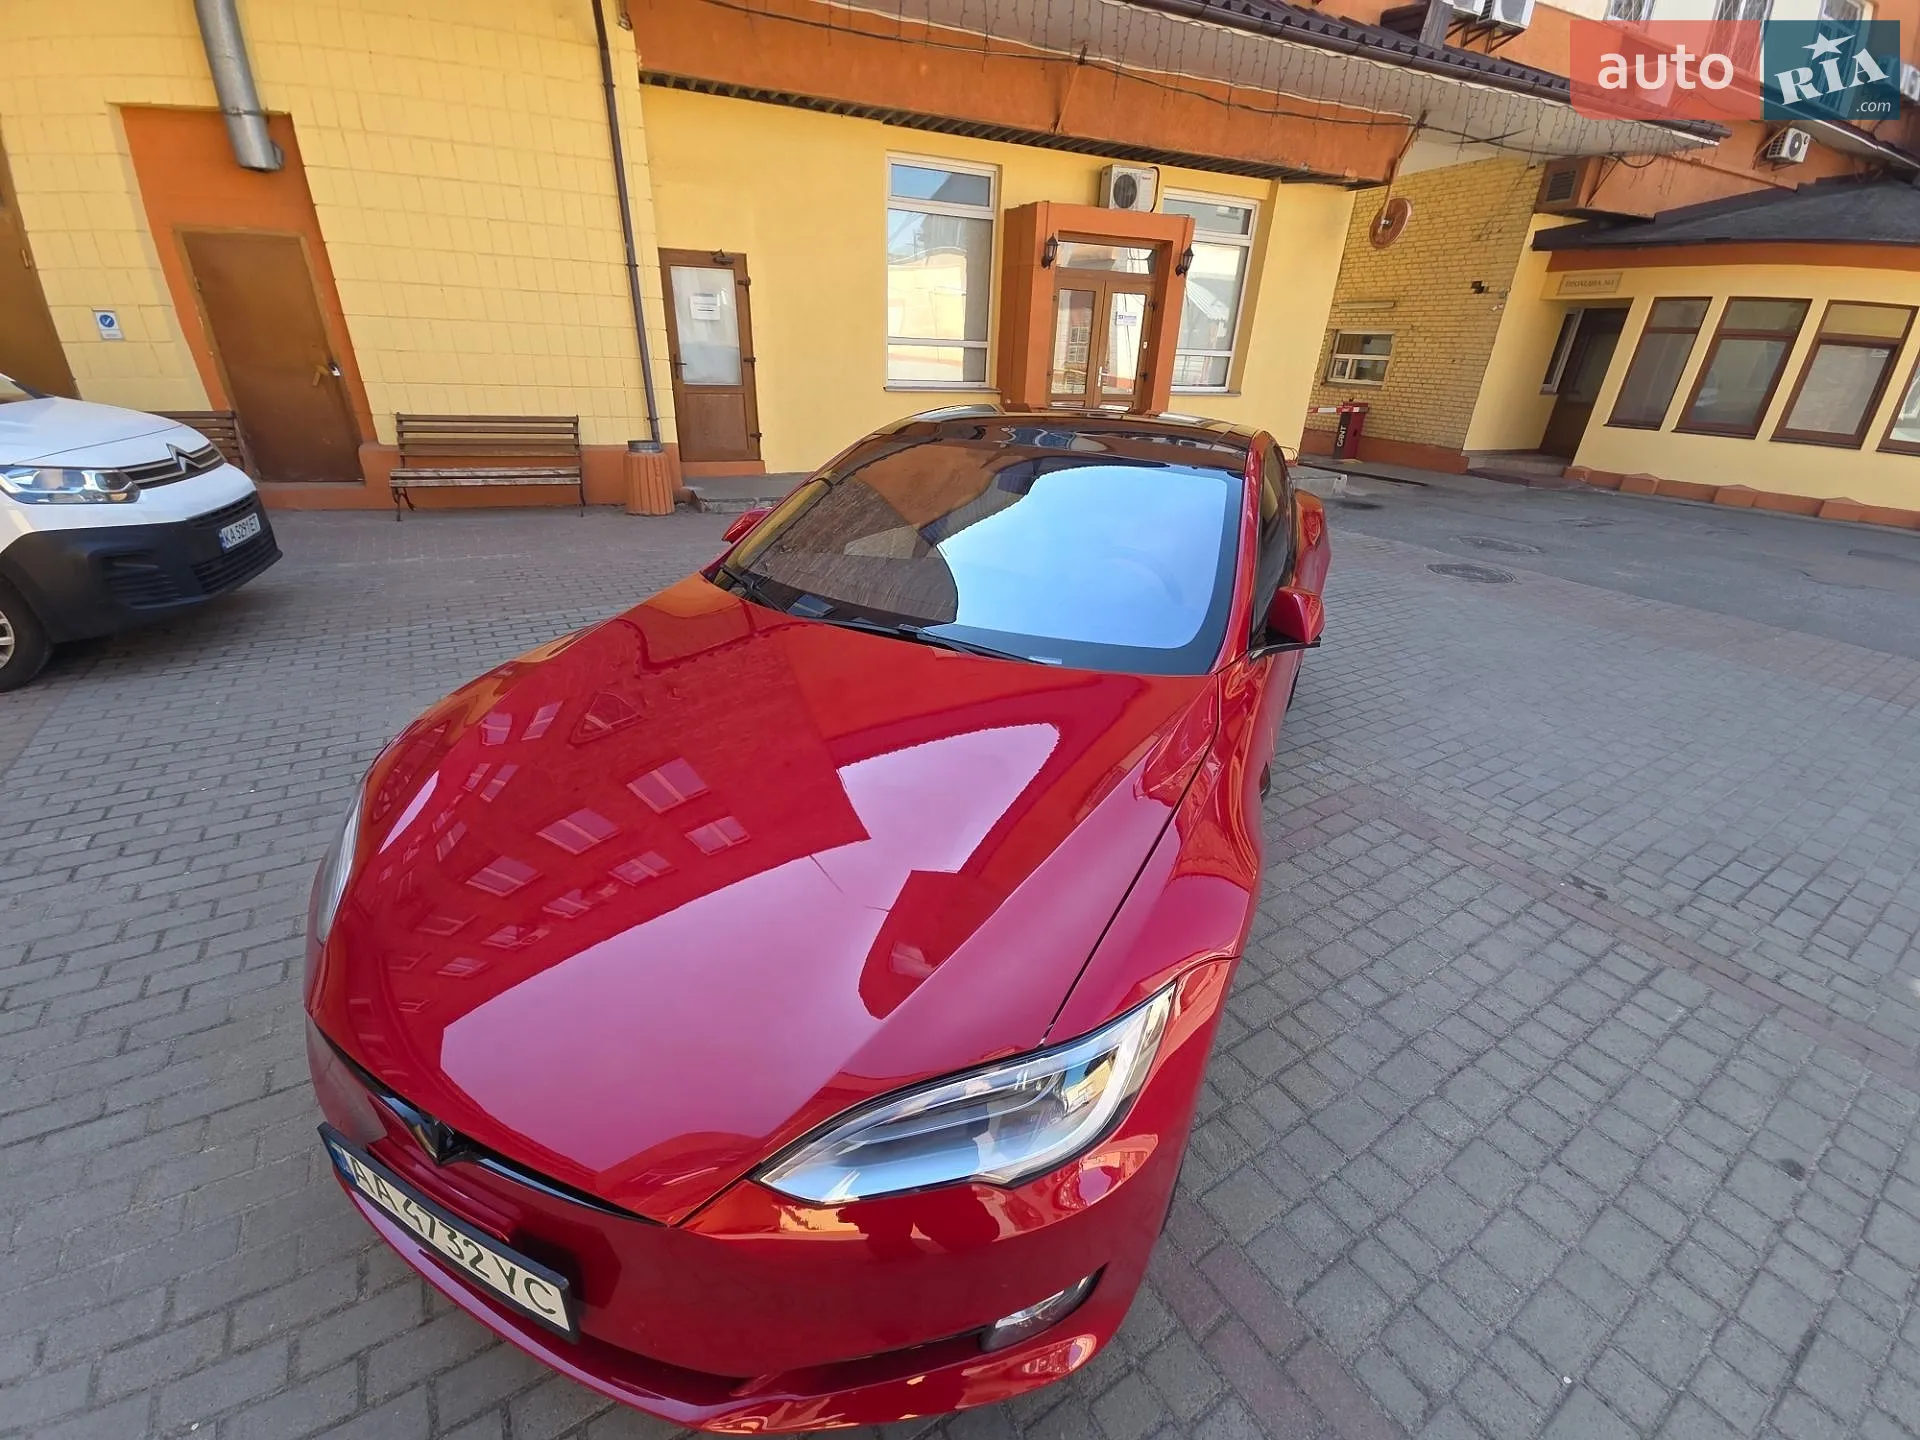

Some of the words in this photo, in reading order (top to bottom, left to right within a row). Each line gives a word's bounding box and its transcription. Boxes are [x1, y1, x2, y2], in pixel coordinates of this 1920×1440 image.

[351, 1158, 399, 1212] AA
[404, 1198, 490, 1279] 4732
[493, 1254, 556, 1315] YC
